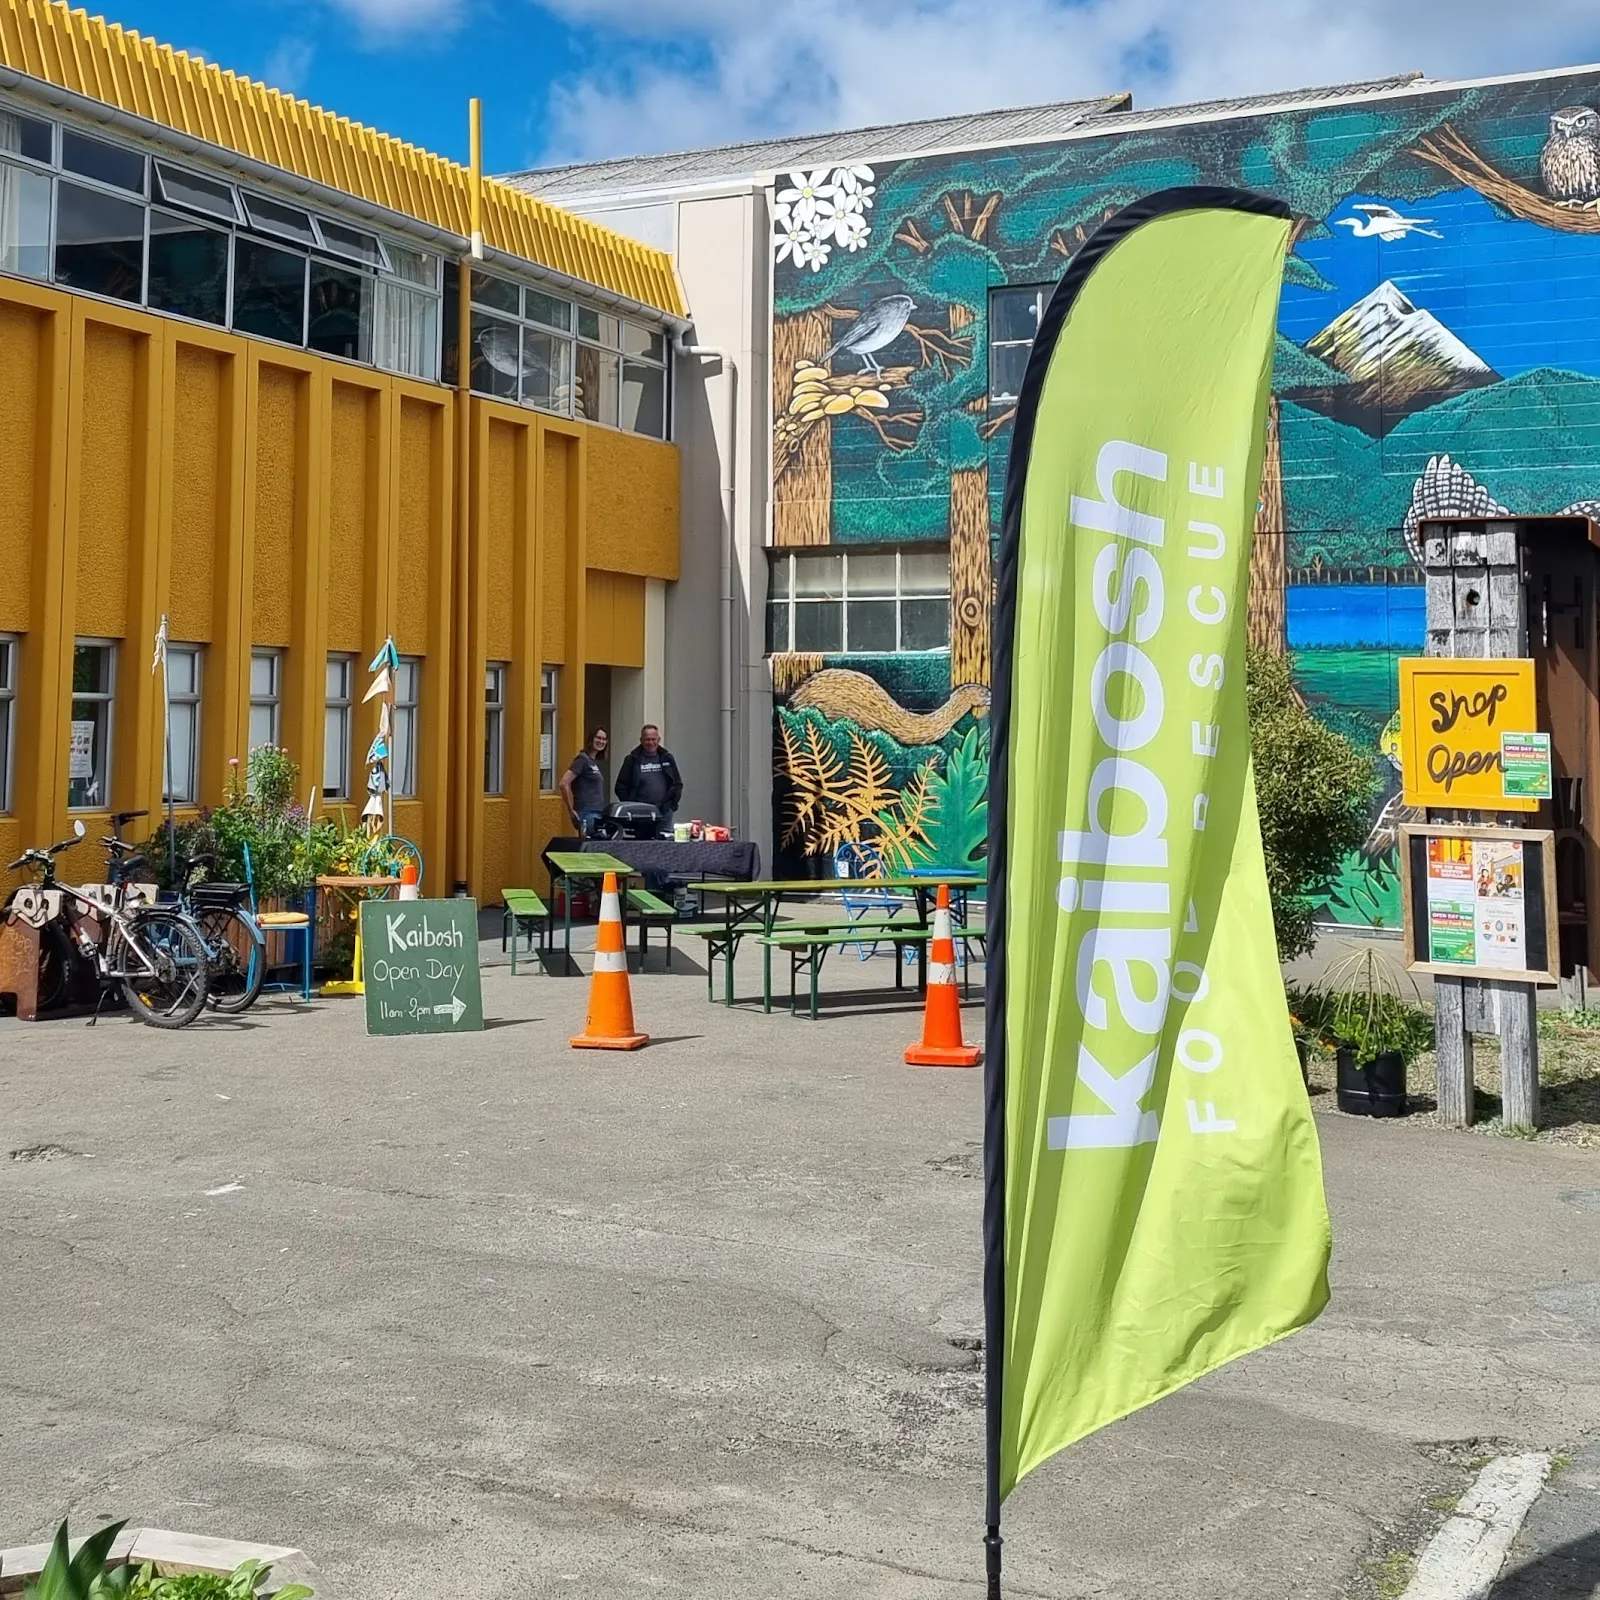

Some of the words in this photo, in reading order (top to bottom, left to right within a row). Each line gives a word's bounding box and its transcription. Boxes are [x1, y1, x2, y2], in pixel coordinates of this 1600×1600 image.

[1430, 684, 1507, 733] Shop
[1427, 744, 1509, 793] Open
[1047, 440, 1172, 1150] kaibosh
[386, 912, 463, 954] Kaibosh
[373, 959, 420, 991] Open
[425, 958, 465, 996] Day
